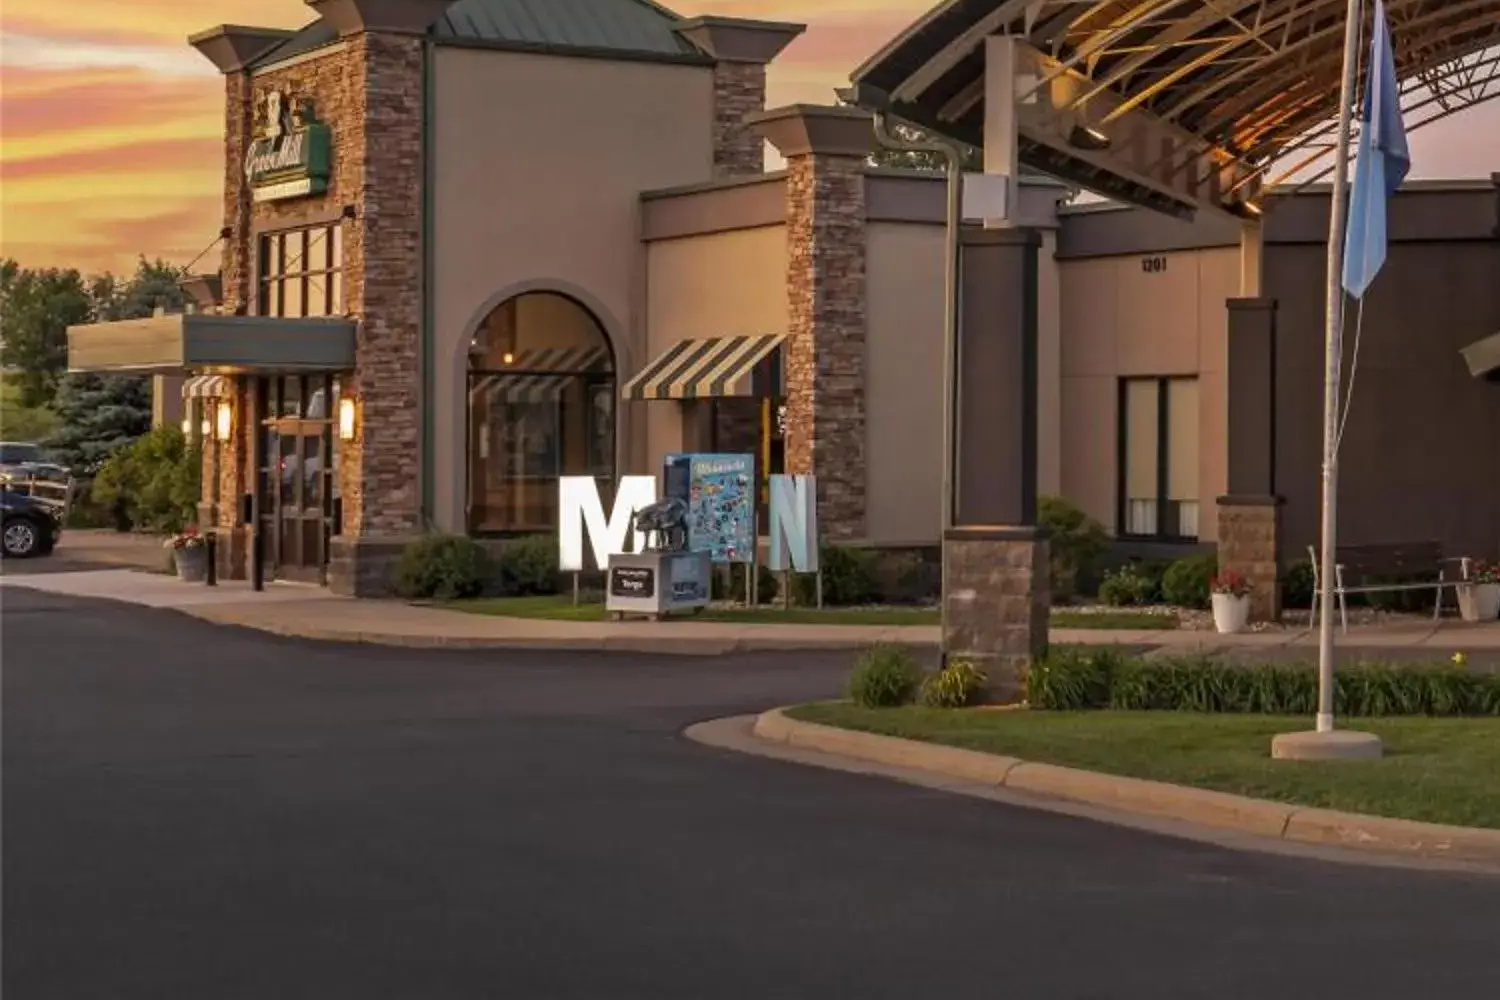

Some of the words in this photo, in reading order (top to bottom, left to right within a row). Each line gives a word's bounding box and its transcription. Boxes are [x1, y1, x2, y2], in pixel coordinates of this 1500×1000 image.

[1142, 256, 1167, 273] 1201
[559, 475, 656, 571] M
[769, 474, 818, 573] N
